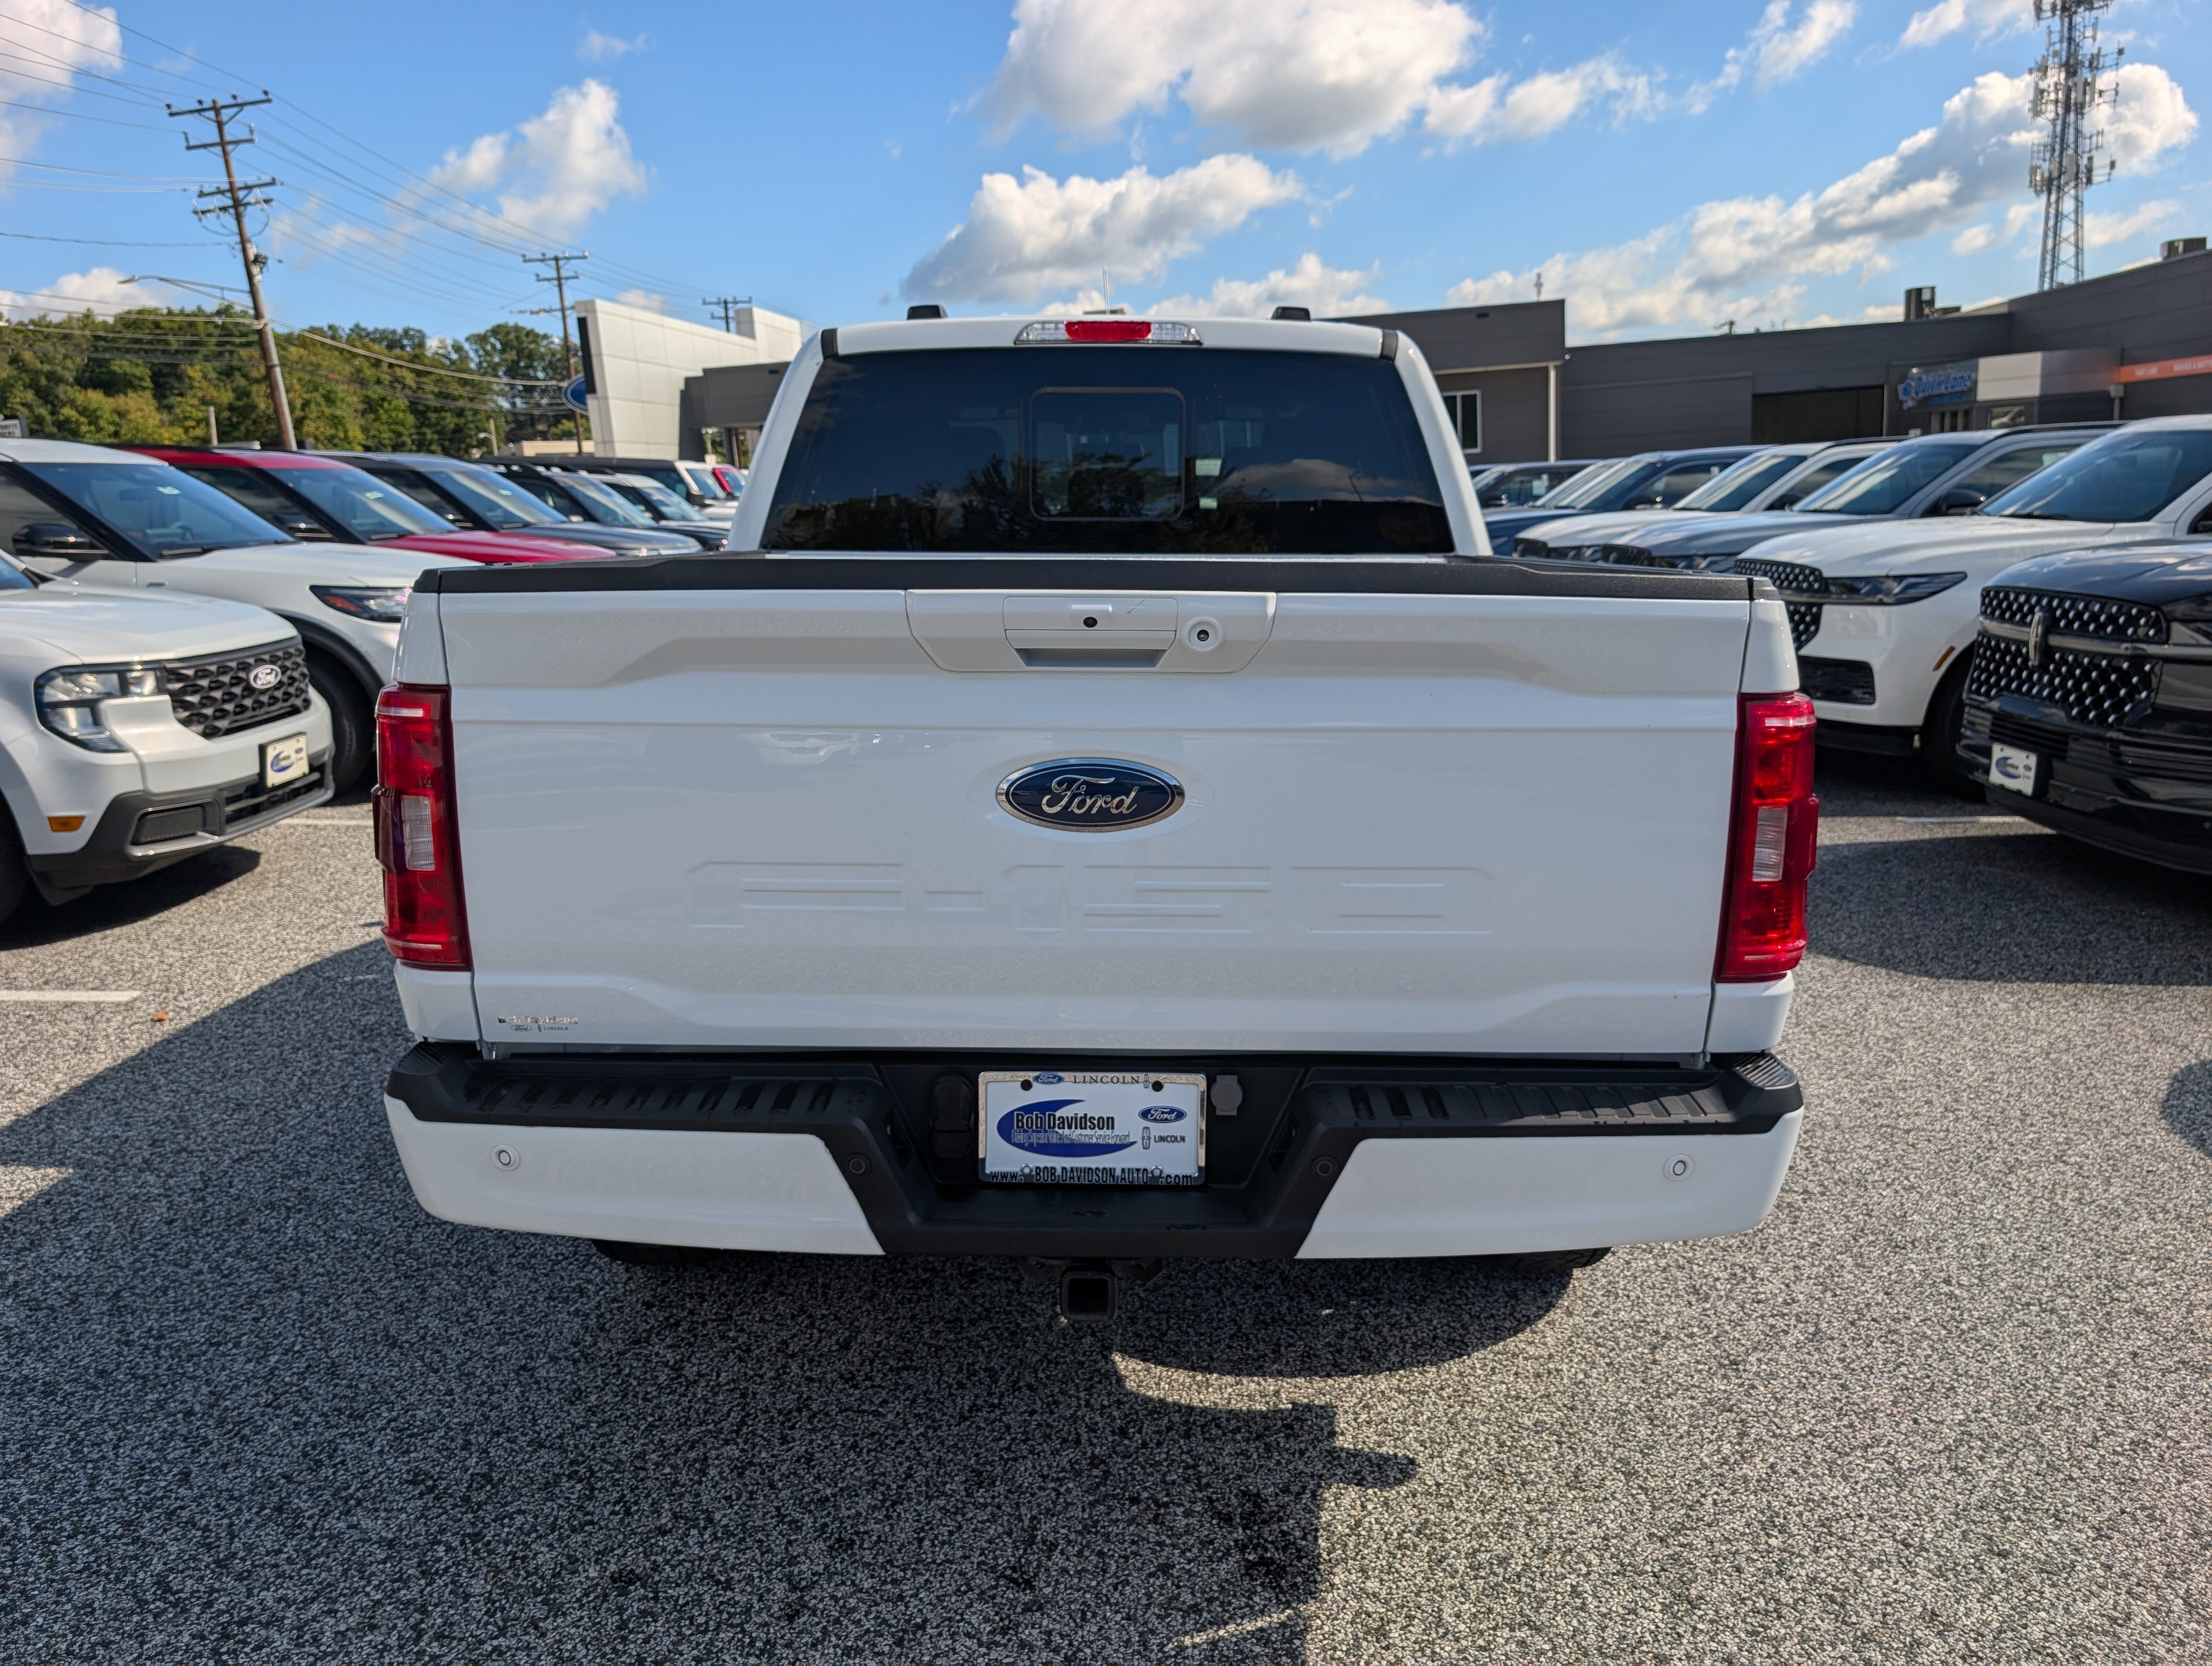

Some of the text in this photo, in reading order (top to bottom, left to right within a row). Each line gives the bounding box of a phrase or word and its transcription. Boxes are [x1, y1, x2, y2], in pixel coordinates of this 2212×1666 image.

[257, 668, 276, 685] Ford
[1041, 774, 1140, 814] Ford
[685, 861, 1496, 933] F-150
[1038, 1074, 1140, 1084] Ford LINCOLN
[1015, 1112, 1115, 1130] Bob Davidson
[1147, 1108, 1178, 1120] Ford
[1154, 1135, 1186, 1143] LINCOLN
[1034, 1166, 1057, 1183] BOB
[1060, 1167, 1116, 1184] DAVIDSON
[1119, 1168, 1150, 1184] AUTO
[1159, 1174, 1193, 1185] .com
